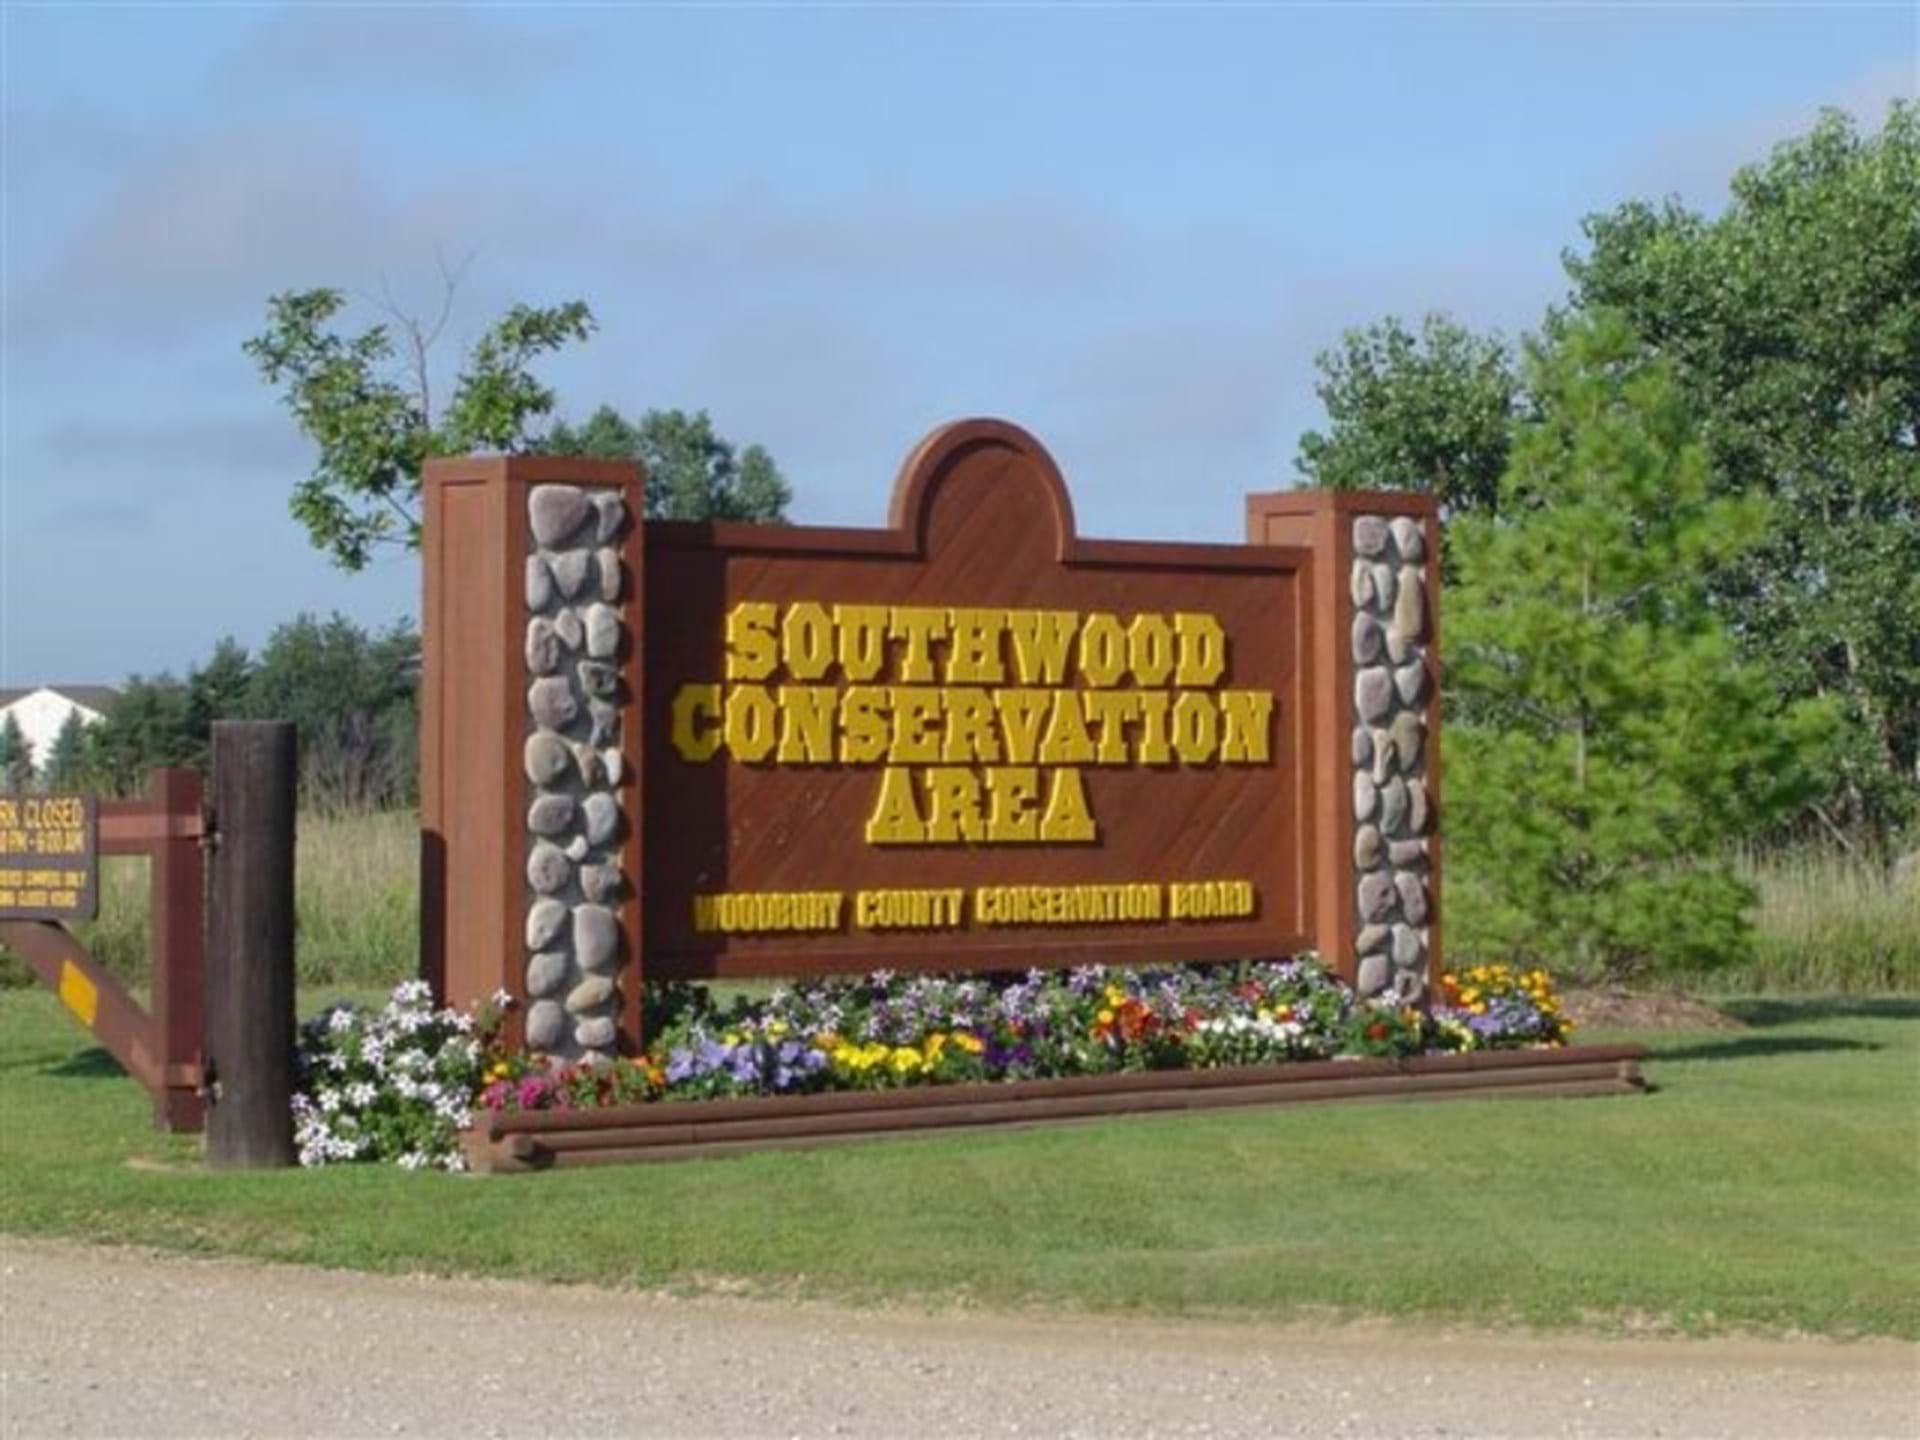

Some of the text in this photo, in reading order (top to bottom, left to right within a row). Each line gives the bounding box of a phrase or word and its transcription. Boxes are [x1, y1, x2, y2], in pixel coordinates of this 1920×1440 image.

[726, 602, 1226, 687] SOUTHWOOD
[671, 685, 1273, 763] CONSERVATION
[23, 798, 84, 829] CLOSED
[865, 766, 1097, 844] AREA
[694, 881, 1255, 932] WOODBURY COUNTY CONSERVATION BOARD
